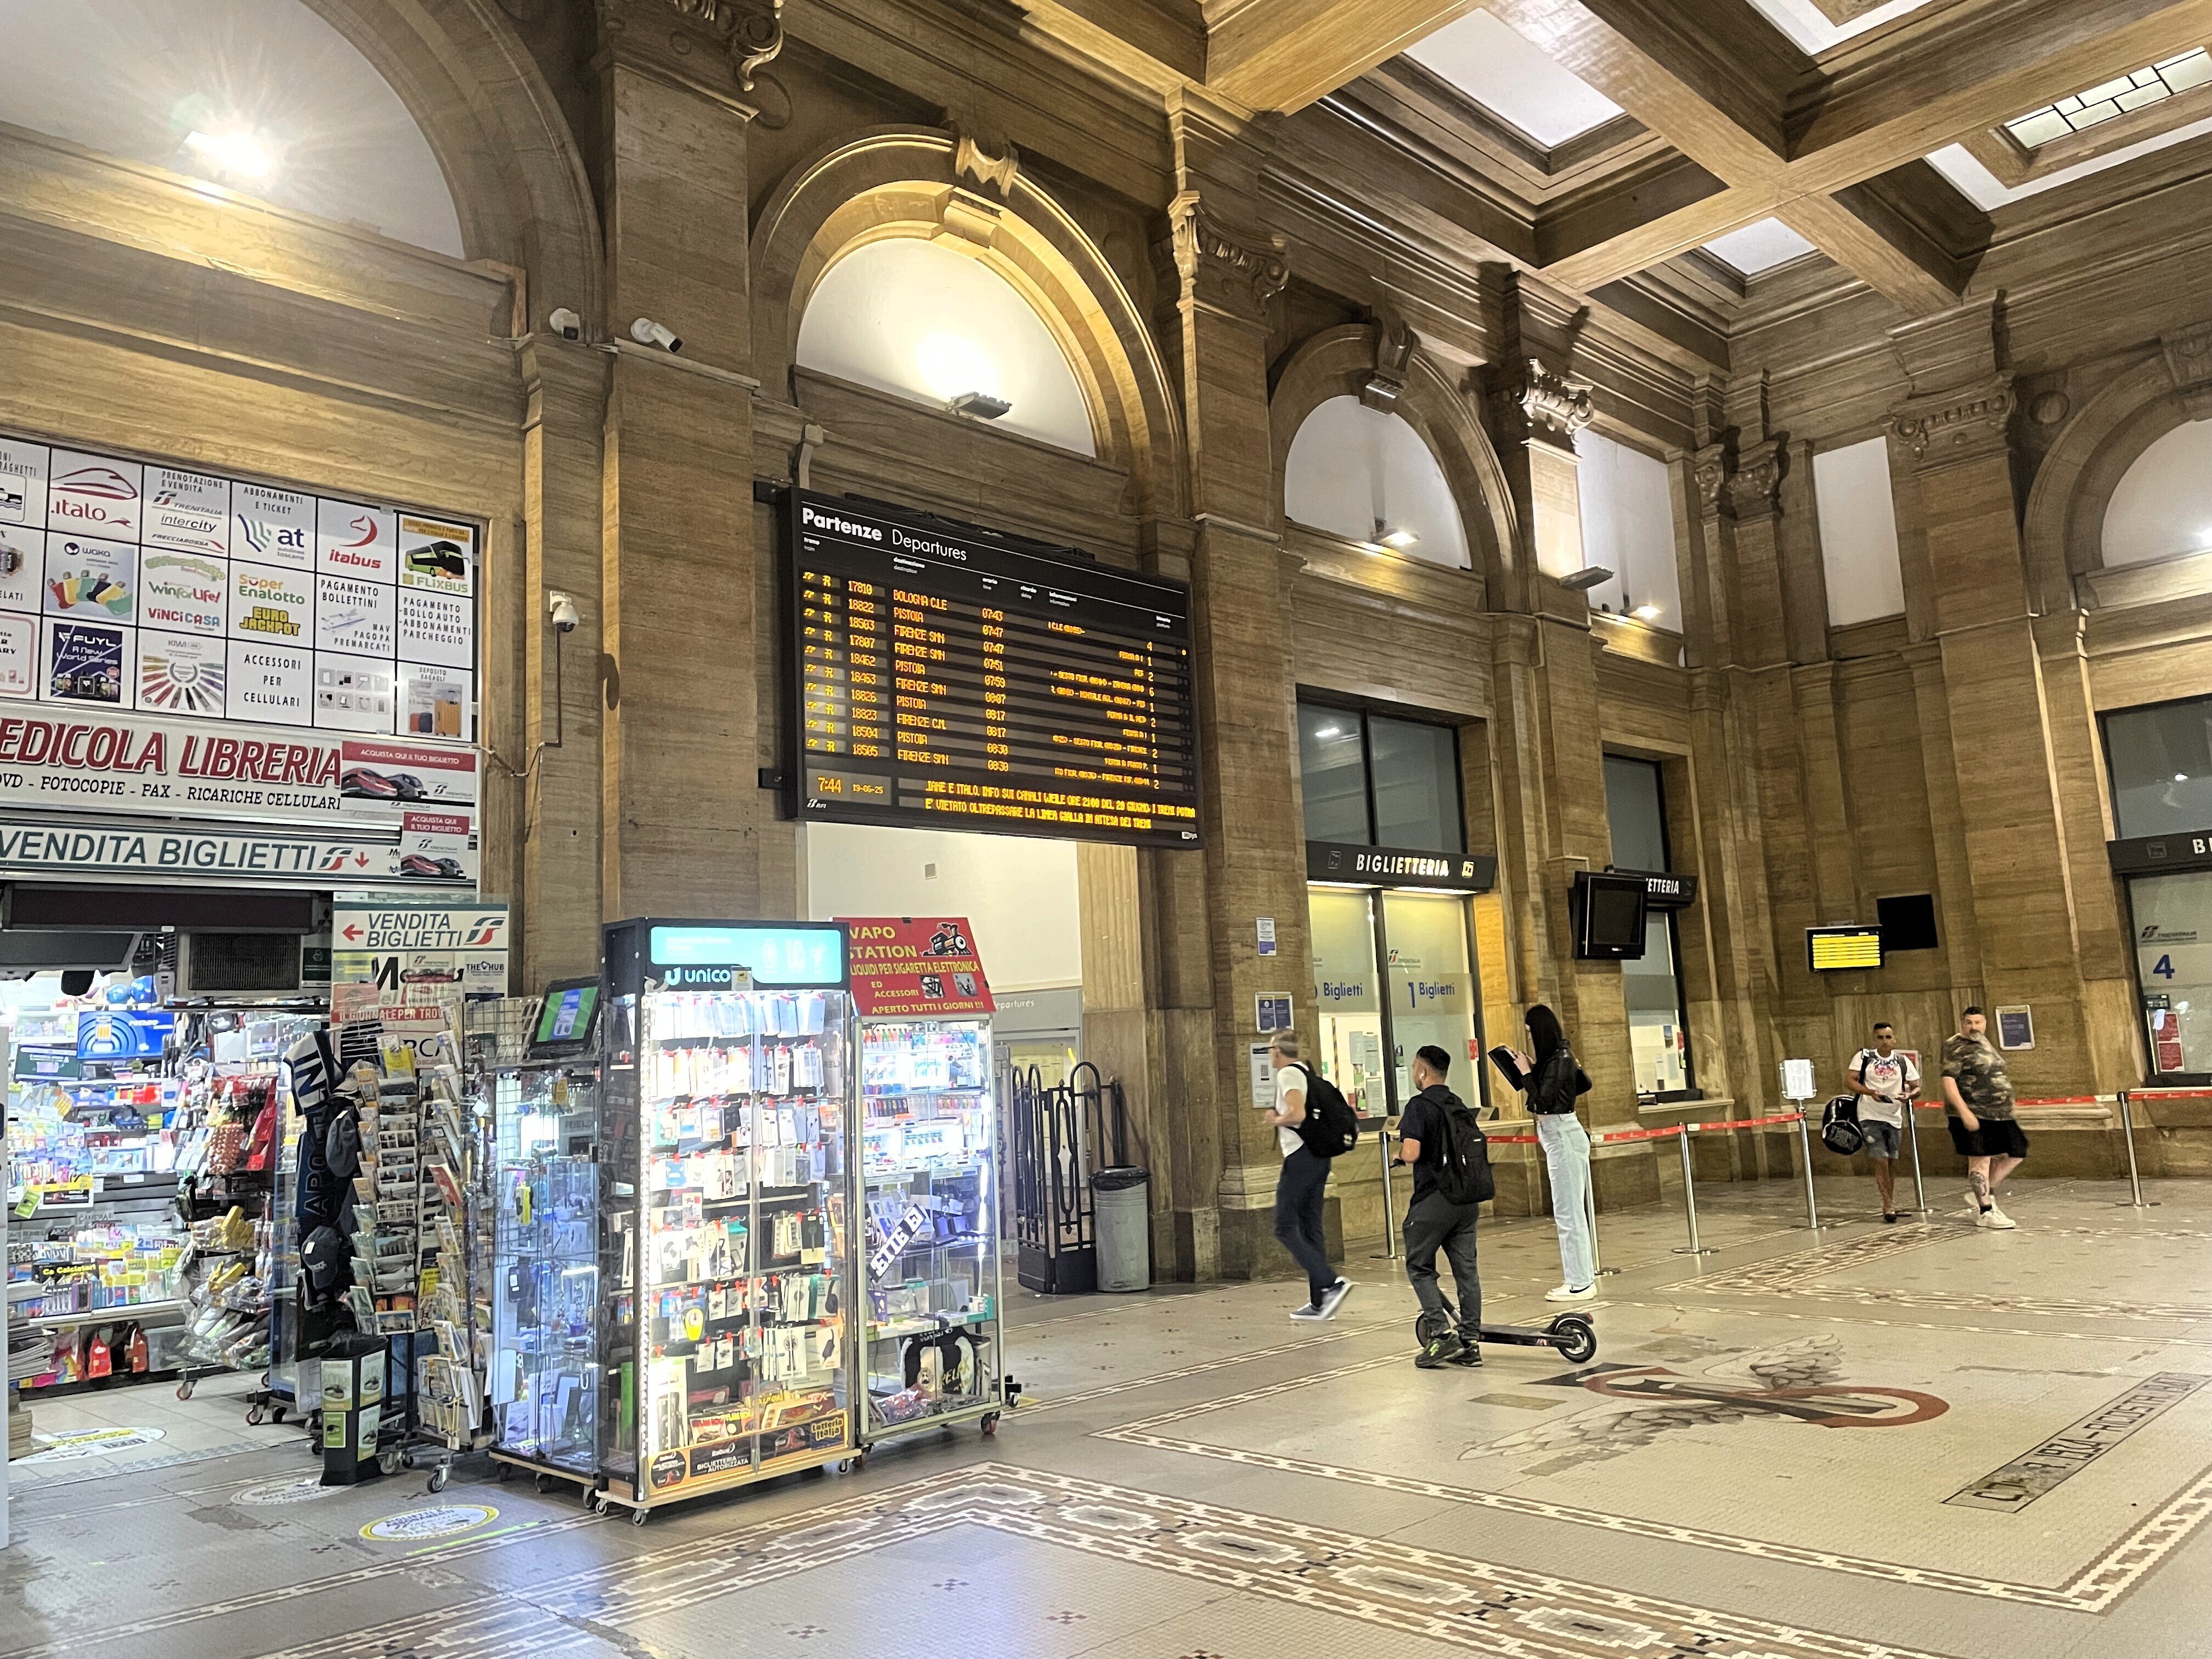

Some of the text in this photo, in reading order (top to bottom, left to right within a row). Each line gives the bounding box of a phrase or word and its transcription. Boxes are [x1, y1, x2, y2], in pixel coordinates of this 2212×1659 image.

[162, 470, 223, 488] PRENOTAZIONE
[168, 482, 202, 494] VENDITA
[244, 487, 303, 505] ABBONAMENTI
[174, 503, 222, 515] TRENITALIA
[263, 503, 291, 515] TICKET
[161, 514, 217, 531] intercity
[152, 534, 208, 546] FRECCIAROSSA
[277, 528, 304, 548] at
[802, 507, 967, 561] Partenze Departures
[329, 549, 381, 569] itabus
[239, 585, 305, 605] Enalotto
[321, 579, 379, 596] PAGAMENTO
[323, 592, 377, 609] BOLLETTINI
[404, 597, 460, 613] PAGAMENTO
[253, 606, 289, 622] EURO
[436, 611, 460, 623] AUTO
[893, 589, 928, 606] BOLOGNA
[1147, 641, 1153, 651] 4
[239, 617, 300, 636] JACKPOT
[373, 623, 390, 632] MAV
[334, 637, 390, 652] PREMARCATI
[403, 629, 463, 645] PARCHEGGIO
[894, 607, 923, 623] PISTOIA
[1148, 656, 1152, 666] 1
[894, 624, 927, 641] FIRENZE
[1148, 672, 1154, 681] 2
[244, 654, 301, 670] ACCESSORI
[895, 642, 927, 658] FIRENZE
[1149, 687, 1154, 697] 6
[419, 667, 447, 676] DEPOSITO
[421, 674, 445, 682] BAGAGLI
[263, 675, 281, 686] PER
[895, 659, 925, 675] PISTOIA
[1150, 703, 1154, 713] 1
[244, 692, 300, 707] CELLULARI
[896, 678, 928, 693] FIRENZE
[1150, 718, 1156, 727] 2
[896, 695, 926, 710] PISTOIA
[1152, 733, 1156, 743] 1
[896, 713, 929, 728] FIRENZE
[1152, 749, 1158, 758] 2
[0, 718, 341, 787] EDICOLA LIBRERIA
[360, 749, 393, 758] ACQUISTA
[429, 755, 459, 764] BIGLIETTO
[897, 731, 927, 745] PISTOIA
[1153, 764, 1158, 774] 1
[898, 749, 930, 763] FIRENZE
[1154, 780, 1160, 790] 2
[41, 776, 341, 810] FOTOCOPIE FAX RICARICHE CELLULARI
[817, 776, 842, 794] 7:44
[948, 782, 955, 794] E
[957, 783, 980, 796] ITALO.
[982, 786, 1000, 798] INFO
[1016, 790, 1041, 802] CANALI
[1101, 798, 1115, 810] DEL
[935, 799, 967, 812] VIETATO
[969, 802, 1024, 818] OLTREPASSARE
[1025, 808, 1035, 819] LA
[1036, 809, 1058, 821] LINEA
[1059, 811, 1084, 823] GIALLA
[1085, 813, 1093, 824] IN
[1094, 814, 1119, 826] ATTESA
[1119, 816, 1132, 828] DEI
[431, 825, 462, 833] BIGLIETTO
[0, 830, 317, 871] VENDITA BIGLIETTI
[1356, 854, 1449, 877] BIGLIETTERIA
[1646, 878, 1679, 894] ETTERIA
[369, 913, 450, 929] VENDITA
[366, 930, 462, 947] BIGLIETTI
[850, 961, 980, 976] LIQUIDI PER SIGARETTA ELETTRONICA
[2153, 954, 2175, 979] 4
[685, 968, 731, 983] unico
[874, 990, 919, 998] ACCESSORI
[1323, 981, 1363, 1000] Biglietti
[1408, 981, 1454, 1008] 1 Biglietti
[398, 1008, 415, 1020] PER
[872, 1004, 910, 1014] APERTO
[910, 1002, 937, 1013] TUTTI
[943, 1002, 973, 1010] GIORNI
[994, 1000, 1035, 1011] epartures
[811, 1418, 843, 1433] Lotteria
[816, 1426, 840, 1441] Italia
[697, 1456, 737, 1470] BIGLIETTERIA
[708, 1459, 748, 1473] AUTORIZZATA
